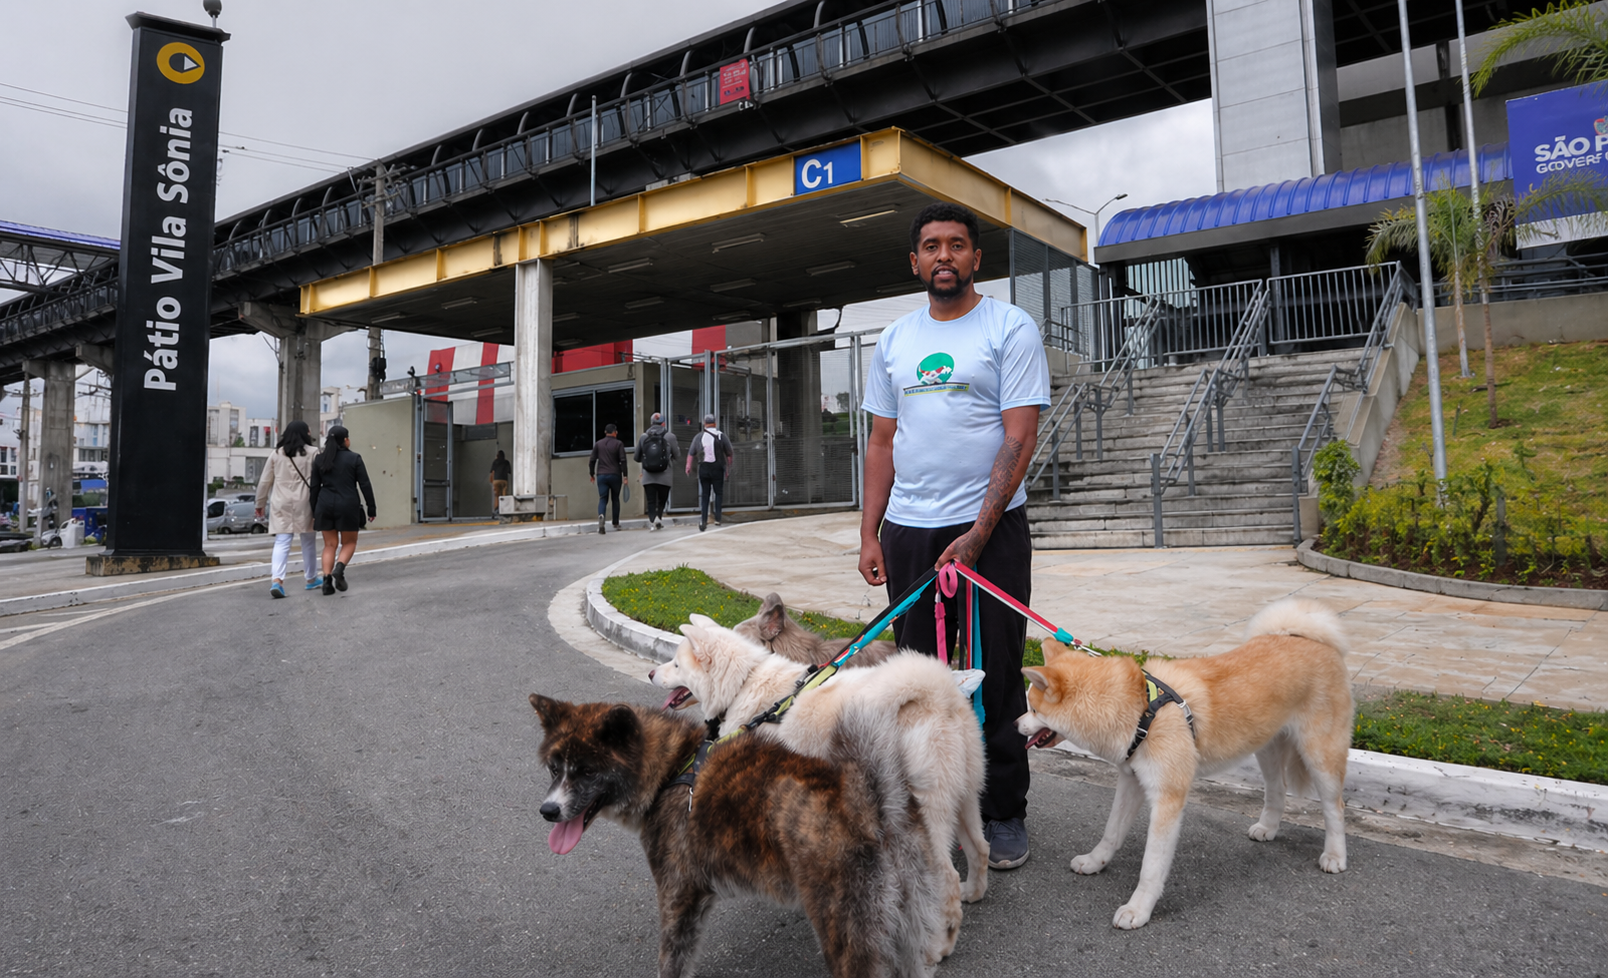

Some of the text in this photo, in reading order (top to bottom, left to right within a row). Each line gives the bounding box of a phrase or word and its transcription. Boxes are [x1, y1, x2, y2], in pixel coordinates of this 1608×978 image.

[1534, 135, 1591, 162] SÃO
[801, 158, 833, 189] C1
[143, 107, 192, 391] Pátio Vila Sônia
